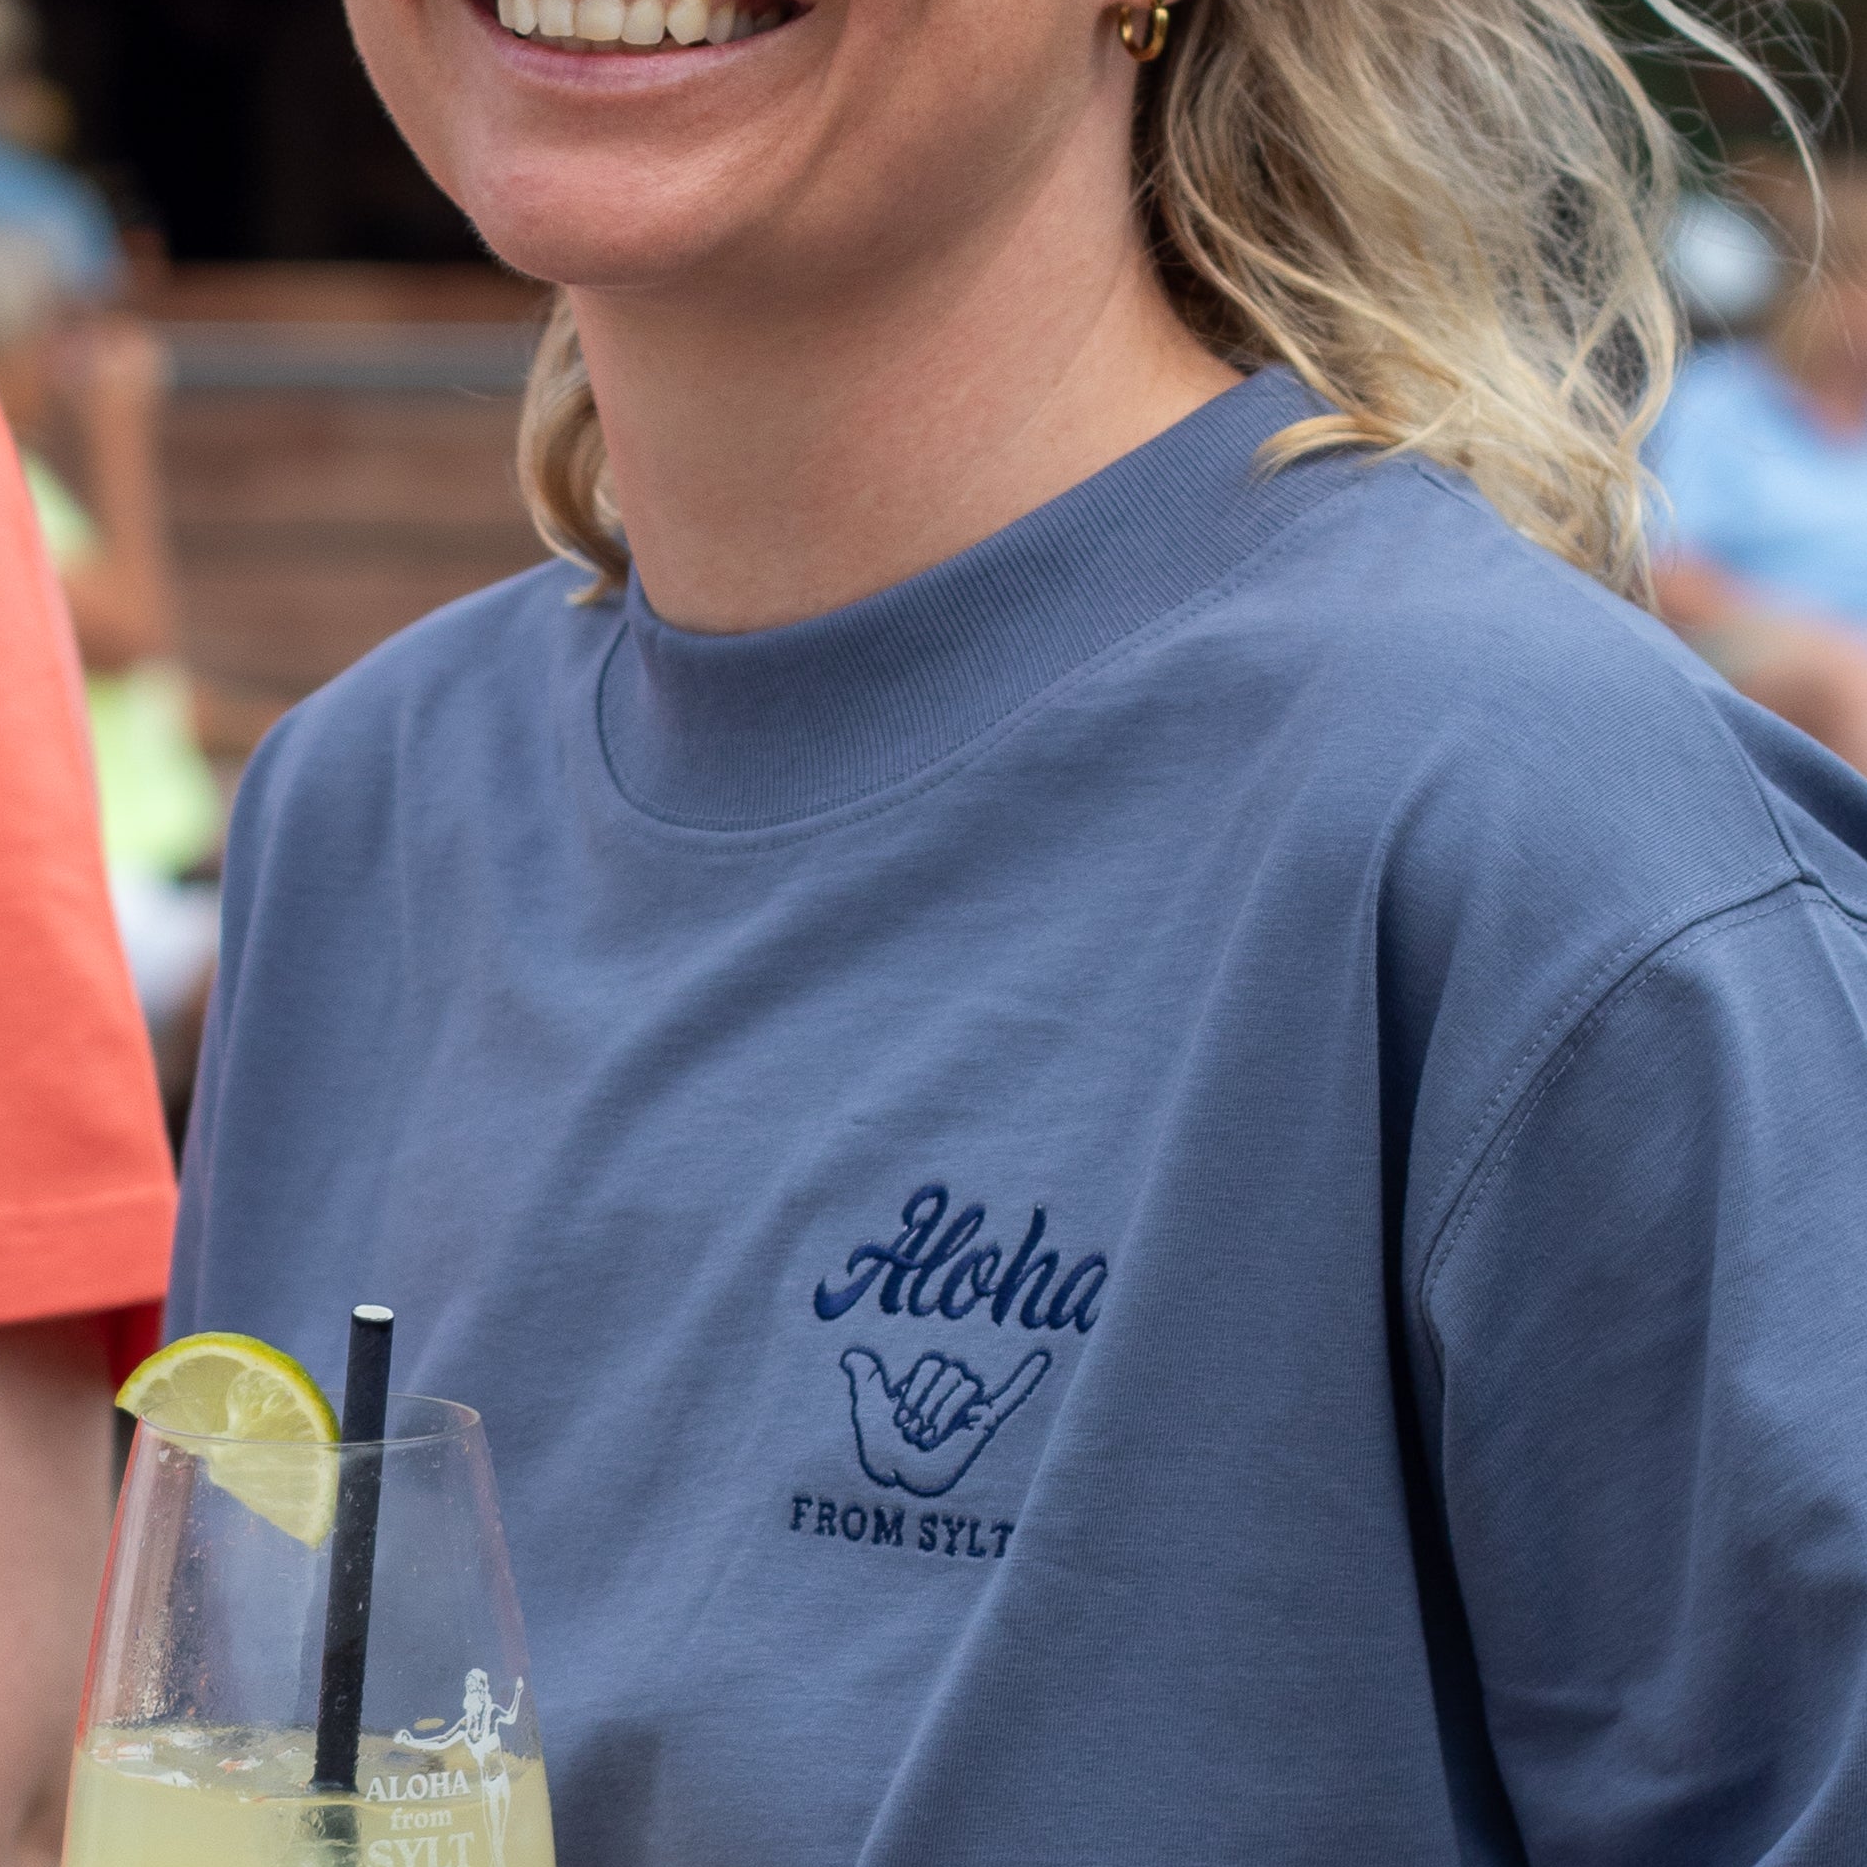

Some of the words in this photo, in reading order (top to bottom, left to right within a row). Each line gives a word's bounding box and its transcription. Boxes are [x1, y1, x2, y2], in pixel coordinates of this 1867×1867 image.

[813, 1179, 1109, 1334] Aloha
[789, 1495, 906, 1547] FROM
[918, 1512, 1015, 1559] SYLT
[363, 1769, 472, 1803] ALOHA
[390, 1807, 454, 1832] from
